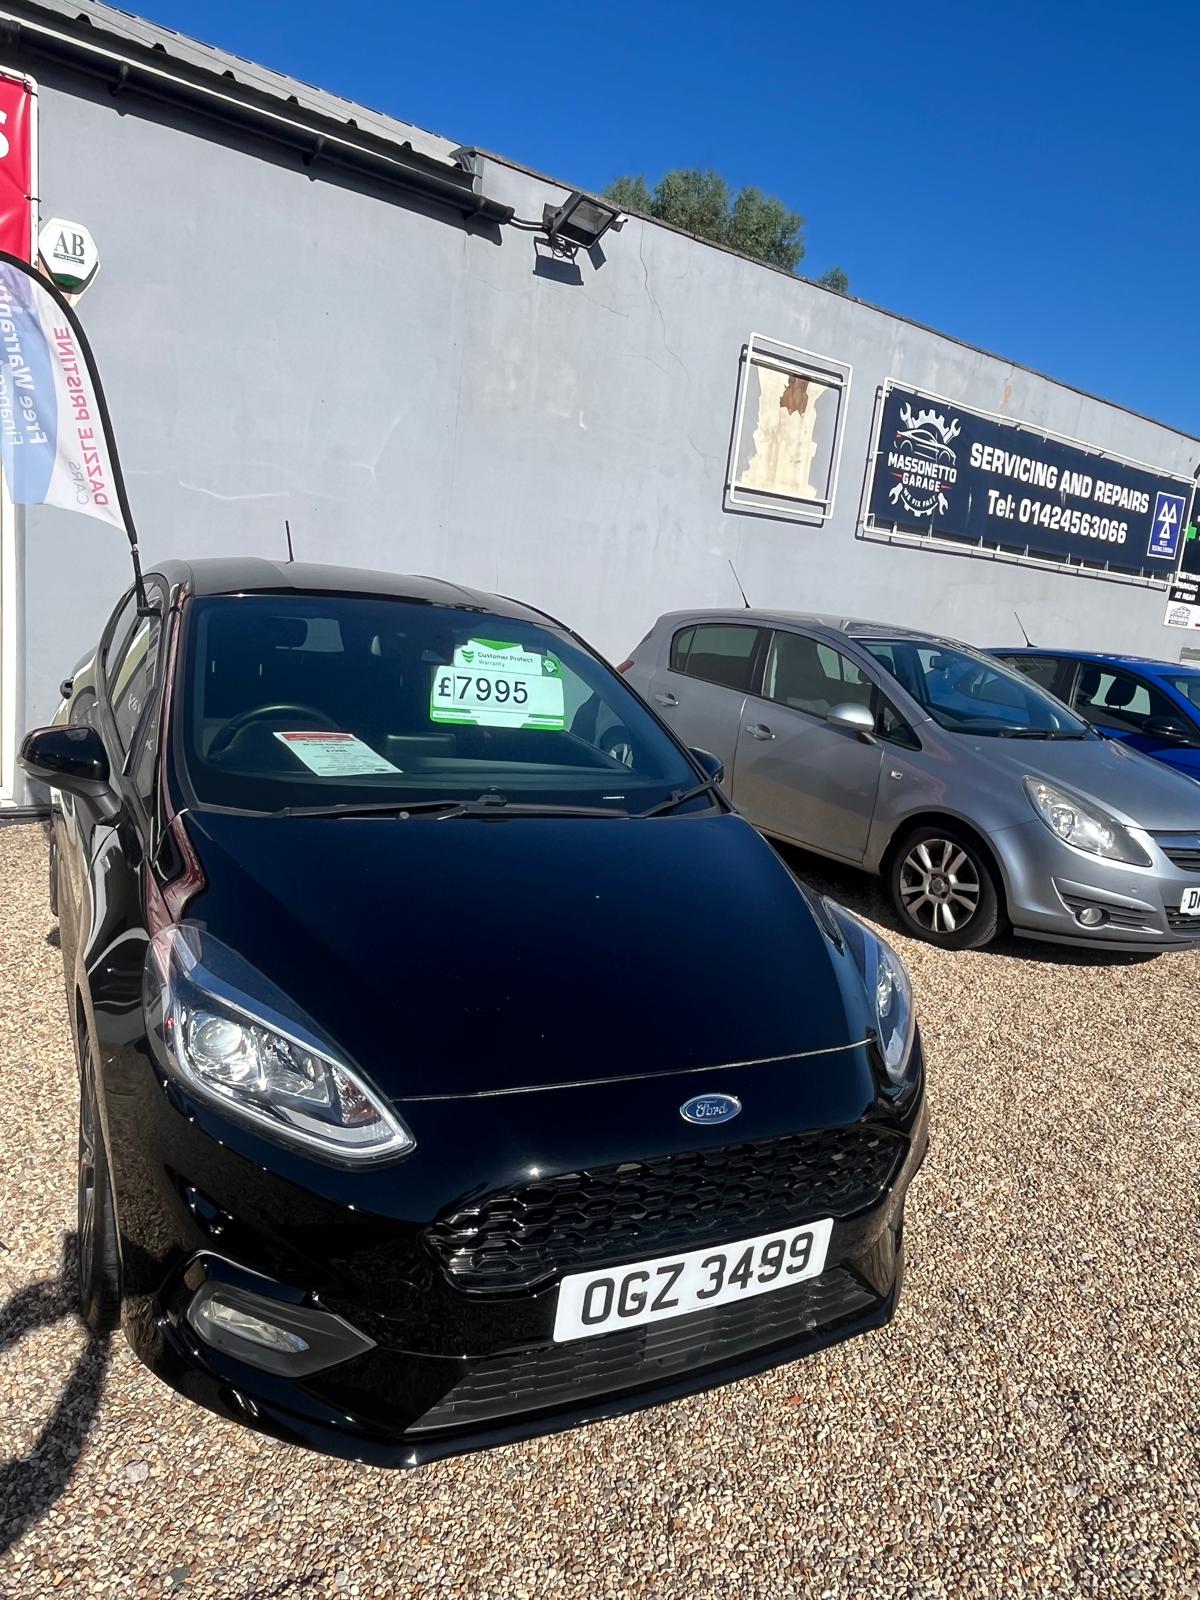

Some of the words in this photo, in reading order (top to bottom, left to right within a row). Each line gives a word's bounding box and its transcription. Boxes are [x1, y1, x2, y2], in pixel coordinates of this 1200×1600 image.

[54, 231, 85, 257] AB
[888, 451, 957, 483] MASSONETTO
[970, 442, 1058, 489] SERVICING
[1059, 470, 1092, 498] AND
[1094, 485, 1150, 514] REPAIRS
[902, 472, 941, 492] GARAGE
[911, 498, 921, 507] FIX
[922, 494, 937, 507] FAST
[988, 489, 1015, 519] Tel:
[1019, 498, 1128, 544] 01424563066
[477, 651, 508, 660] Customer
[509, 655, 533, 663] Protect
[438, 675, 528, 704] £7995
[695, 1099, 729, 1118] Ford
[581, 1262, 686, 1326] OGZ
[696, 1231, 815, 1301] 3499
